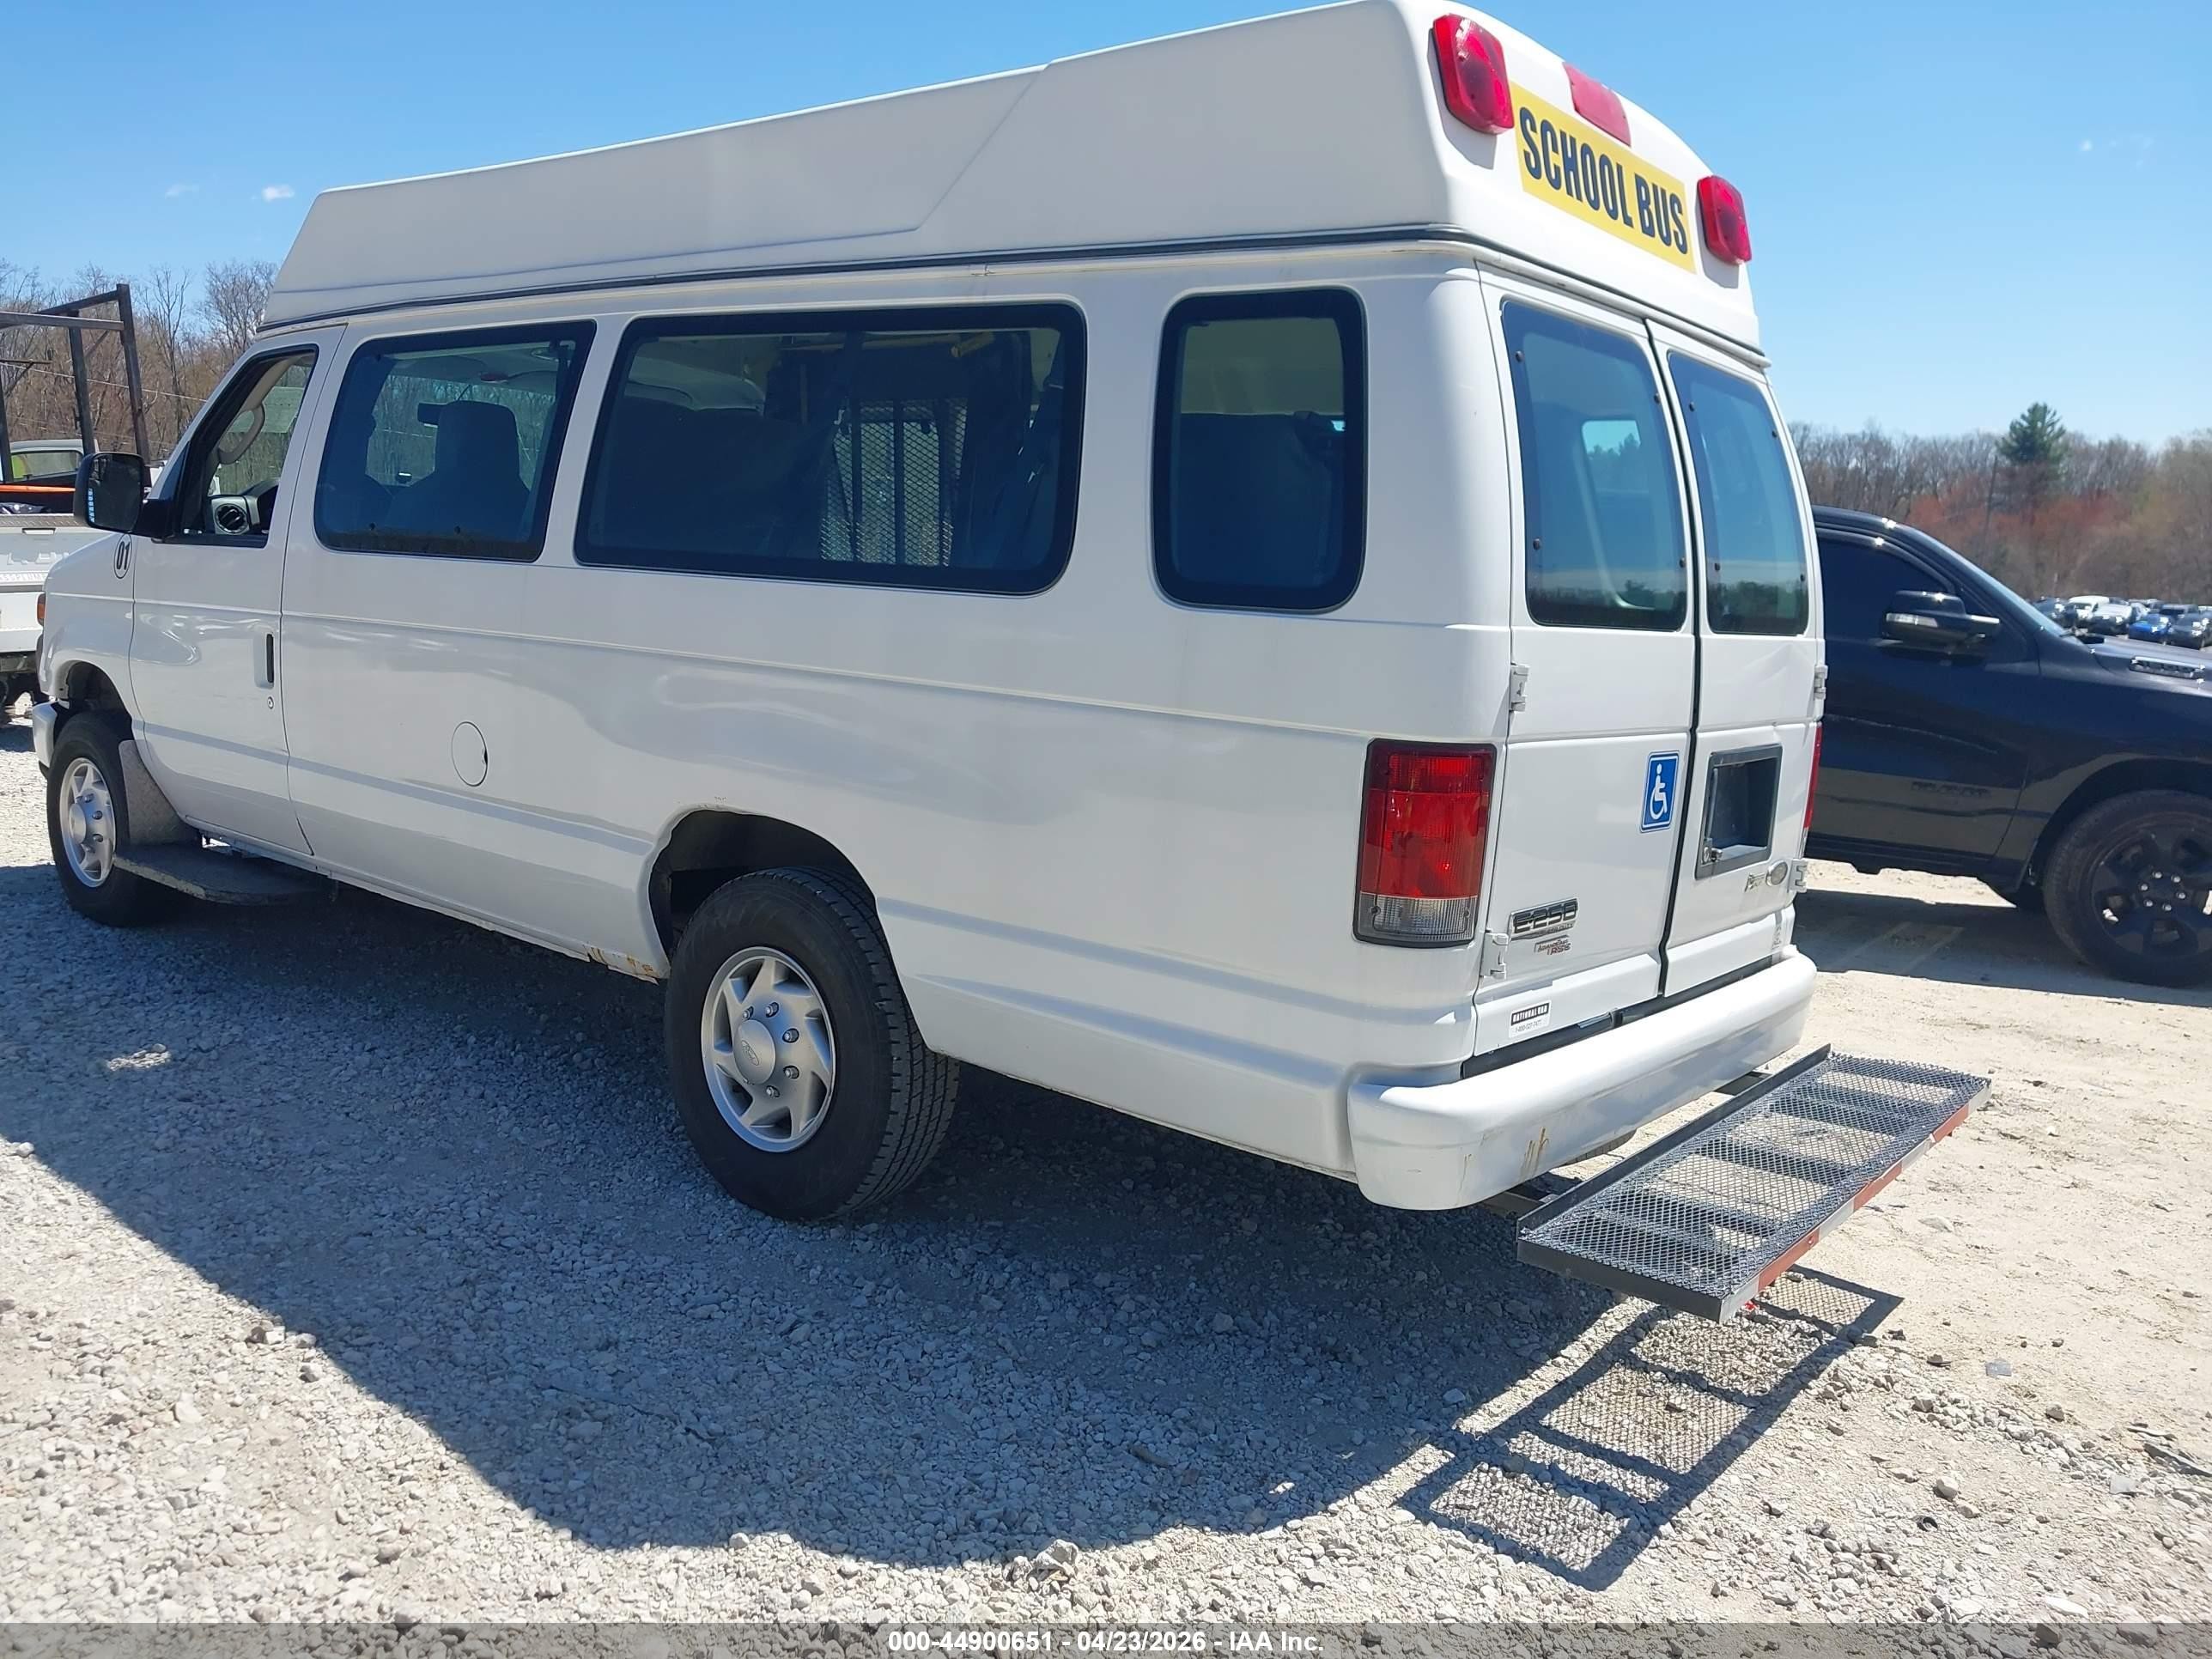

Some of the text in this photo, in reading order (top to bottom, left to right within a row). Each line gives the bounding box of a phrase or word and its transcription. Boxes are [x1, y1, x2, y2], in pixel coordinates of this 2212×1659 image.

[1519, 106, 1688, 255] SCHOOL BUS
[116, 541, 131, 570] 01
